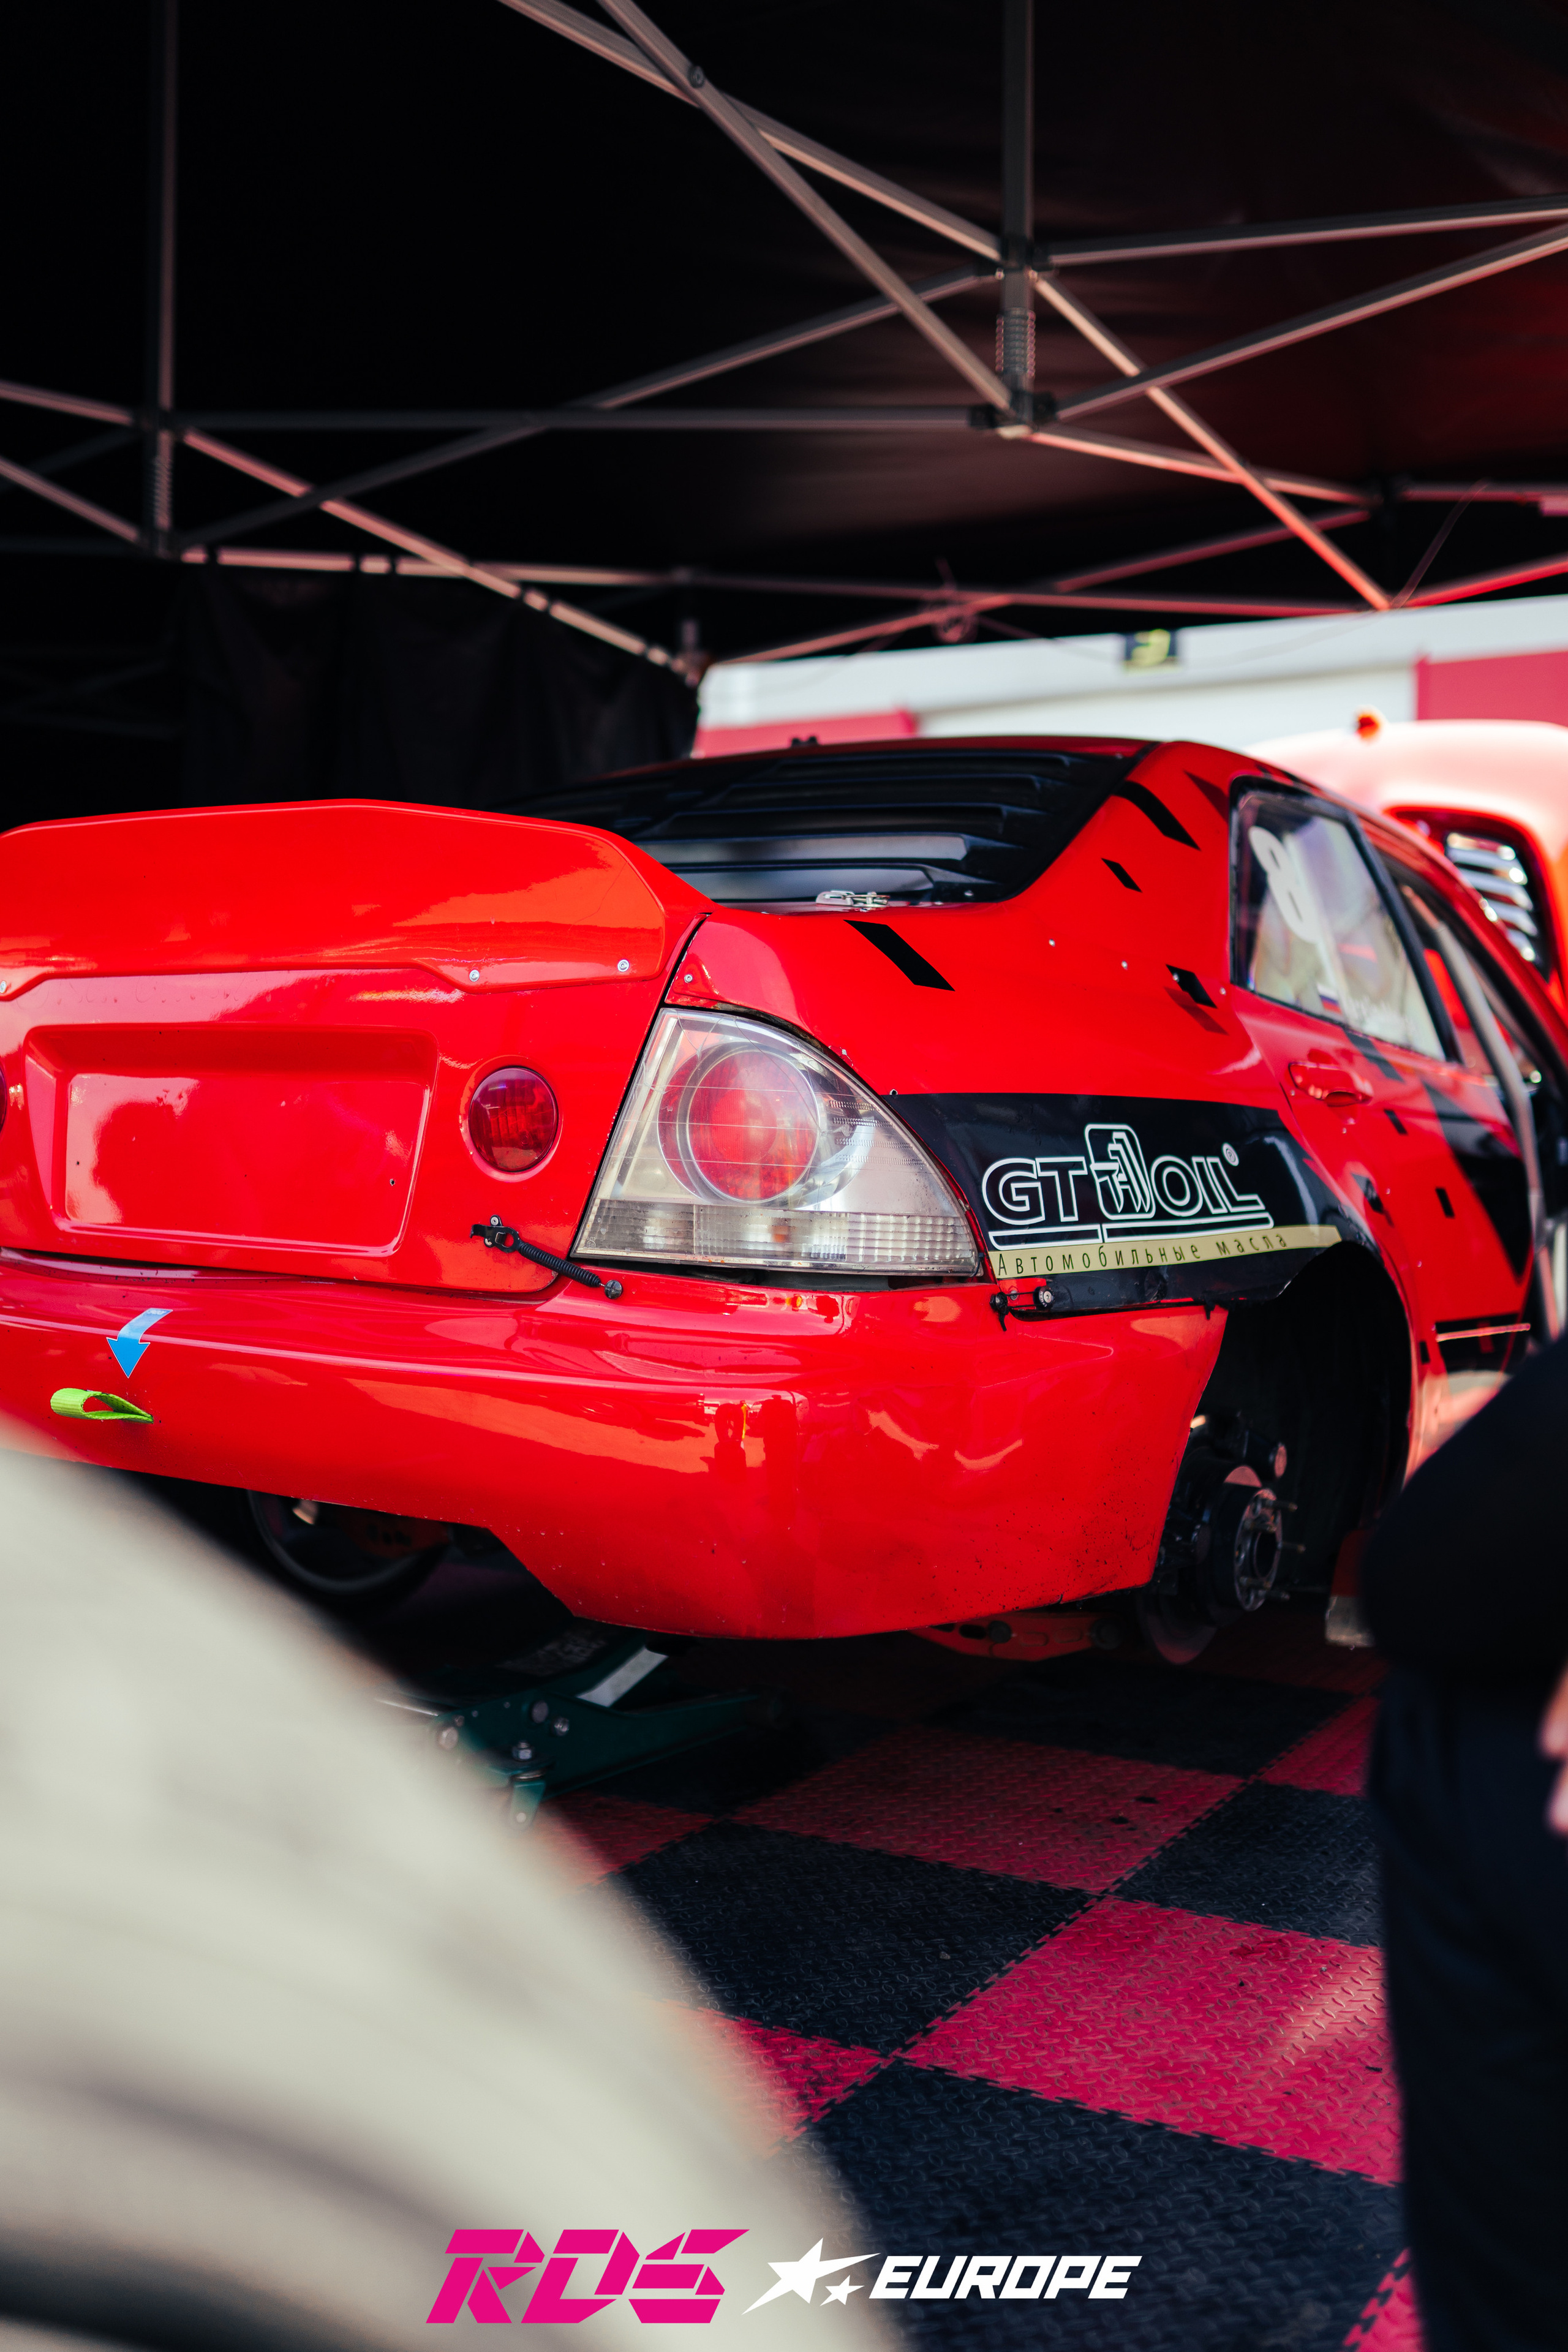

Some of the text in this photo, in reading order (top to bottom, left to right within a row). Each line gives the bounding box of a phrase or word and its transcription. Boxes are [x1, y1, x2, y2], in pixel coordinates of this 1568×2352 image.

[982, 1156, 1088, 1225] GT
[998, 1233, 1287, 1276] Автомобильные масла
